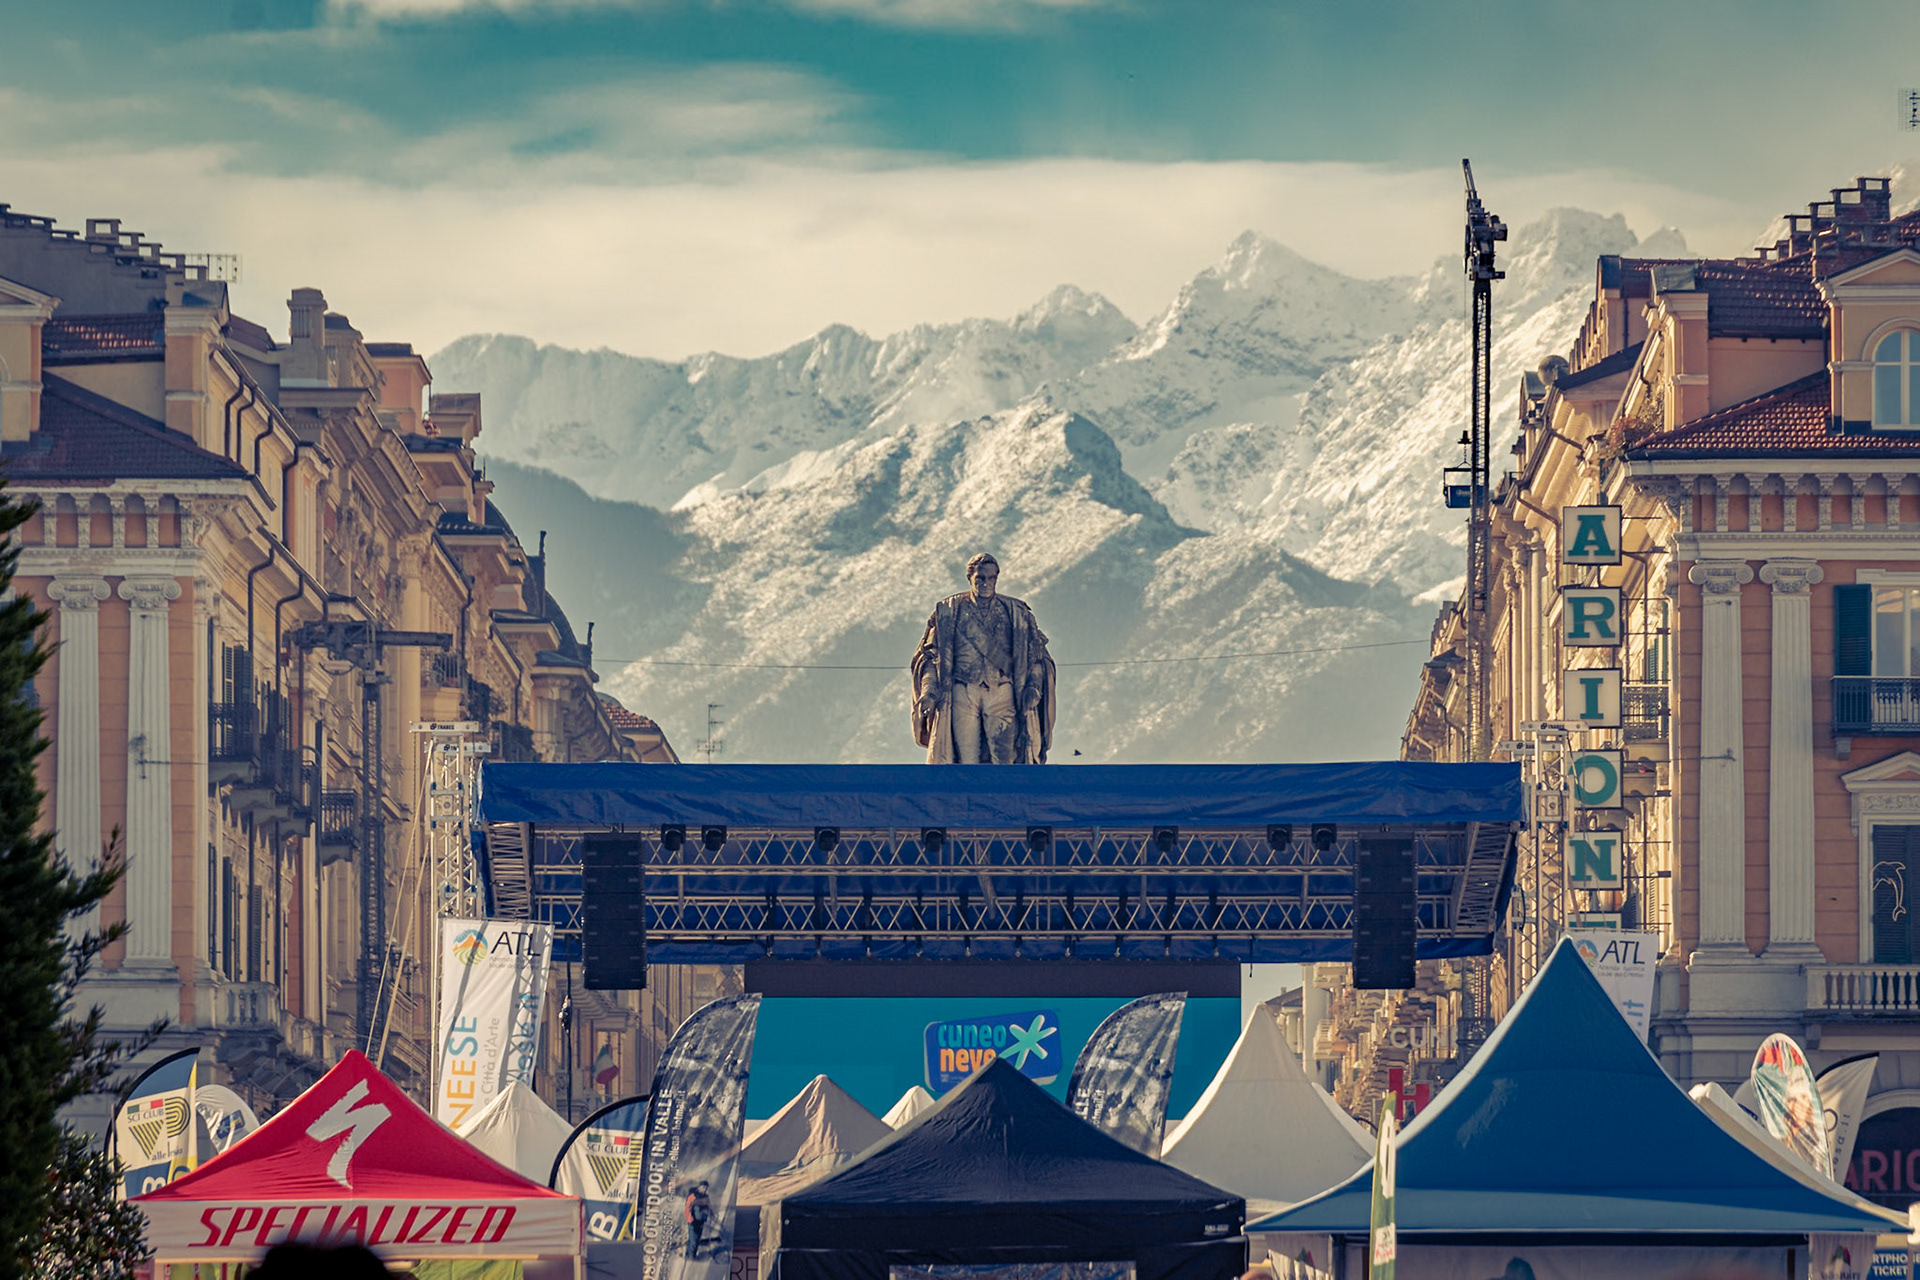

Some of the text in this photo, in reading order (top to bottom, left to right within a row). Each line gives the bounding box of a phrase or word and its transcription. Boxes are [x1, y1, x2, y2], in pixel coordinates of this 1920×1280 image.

[1567, 514, 1617, 928] ARION
[490, 931, 541, 956] ATL
[1600, 940, 1645, 965] ATL
[484, 1018, 500, 1054] d'Arte
[938, 1023, 1006, 1048] cuneo
[940, 1048, 996, 1072] neve
[481, 1060, 495, 1094] Città
[654, 1088, 673, 1138] VALLE
[1074, 1087, 1090, 1120] LLE
[127, 1109, 165, 1124] SCI CLUB
[586, 1143, 629, 1155] SCI CLUB
[651, 1141, 666, 1158] IN
[643, 1162, 664, 1238] OUTDOOR
[187, 1205, 516, 1247] SPECIALIZED
[1872, 1265, 1908, 1277] TICKET
